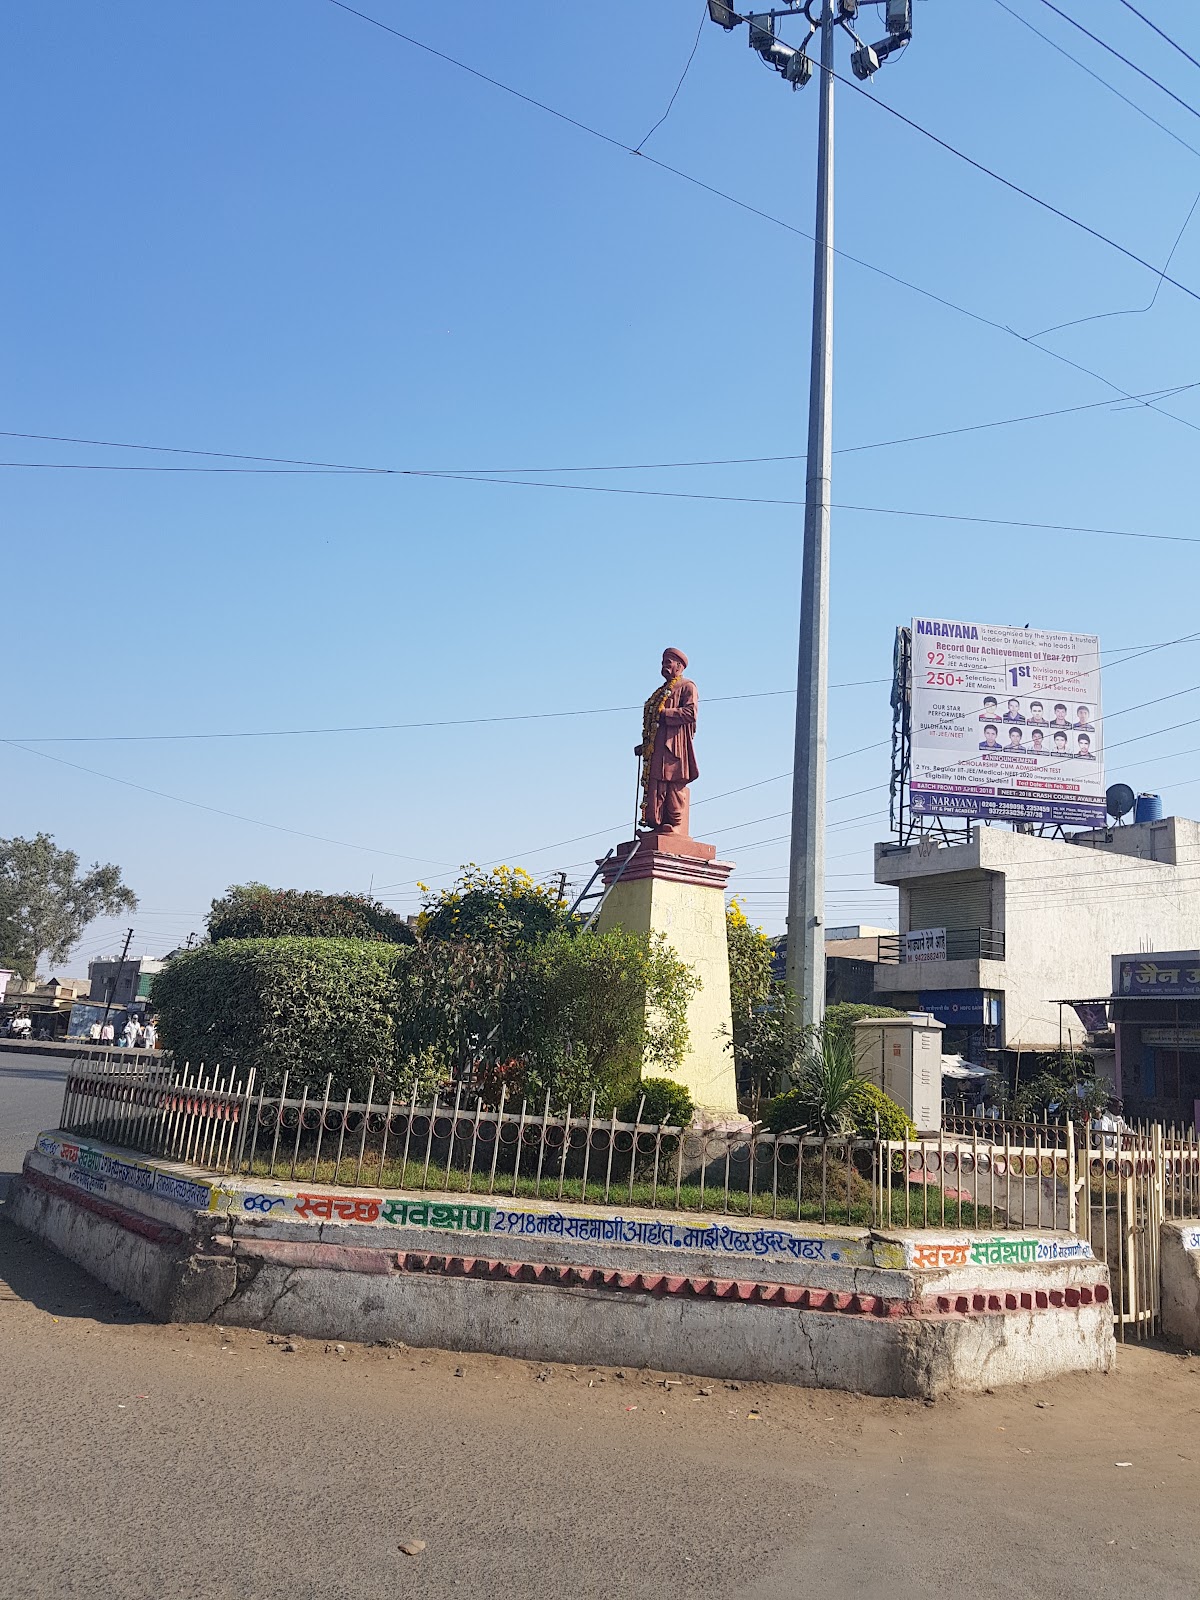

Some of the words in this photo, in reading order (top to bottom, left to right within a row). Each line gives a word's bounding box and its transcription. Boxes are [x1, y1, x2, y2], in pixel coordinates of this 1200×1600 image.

[917, 620, 979, 640] NARAYANA
[987, 628, 1023, 638] recognised
[1025, 631, 1033, 639] by
[1046, 634, 1067, 642] system
[981, 635, 1002, 643] leader
[1054, 642, 1070, 650] leads
[927, 651, 945, 666] 92
[936, 642, 964, 652] Record
[966, 645, 980, 653] Our
[981, 646, 1032, 659] Achievement
[1033, 651, 1042, 660] of
[1042, 653, 1059, 661] Year
[1061, 654, 1078, 663] 2017
[947, 653, 980, 662] Selections
[959, 662, 988, 670] Advance
[1032, 666, 1064, 675] Divisional
[926, 671, 964, 686] 250+
[965, 674, 997, 683] Selections
[1008, 665, 1031, 687] 1st
[1053, 684, 1087, 694] Selections
[932, 703, 946, 711] OUR
[946, 704, 961, 712] STAR
[928, 710, 966, 719] PERFORMERS
[985, 754, 1035, 764] ANNOUNCEMENT
[933, 765, 956, 773] Regular
[958, 759, 999, 768] SCHOLARSHIP
[1015, 763, 1048, 772] ADMISSION
[925, 772, 952, 781] Eligibility
[954, 774, 966, 782] 10th
[931, 796, 978, 808] NARAYANA
[1053, 794, 1077, 802] COURSE
[1135, 963, 1180, 985] जैन
[294, 1193, 383, 1221] स्वच्छ
[566, 1217, 624, 1242] सहभागी
[752, 1228, 793, 1255] सुंदर
[913, 1244, 970, 1268] स्वच्छ
[1038, 1243, 1058, 1259] 2018
